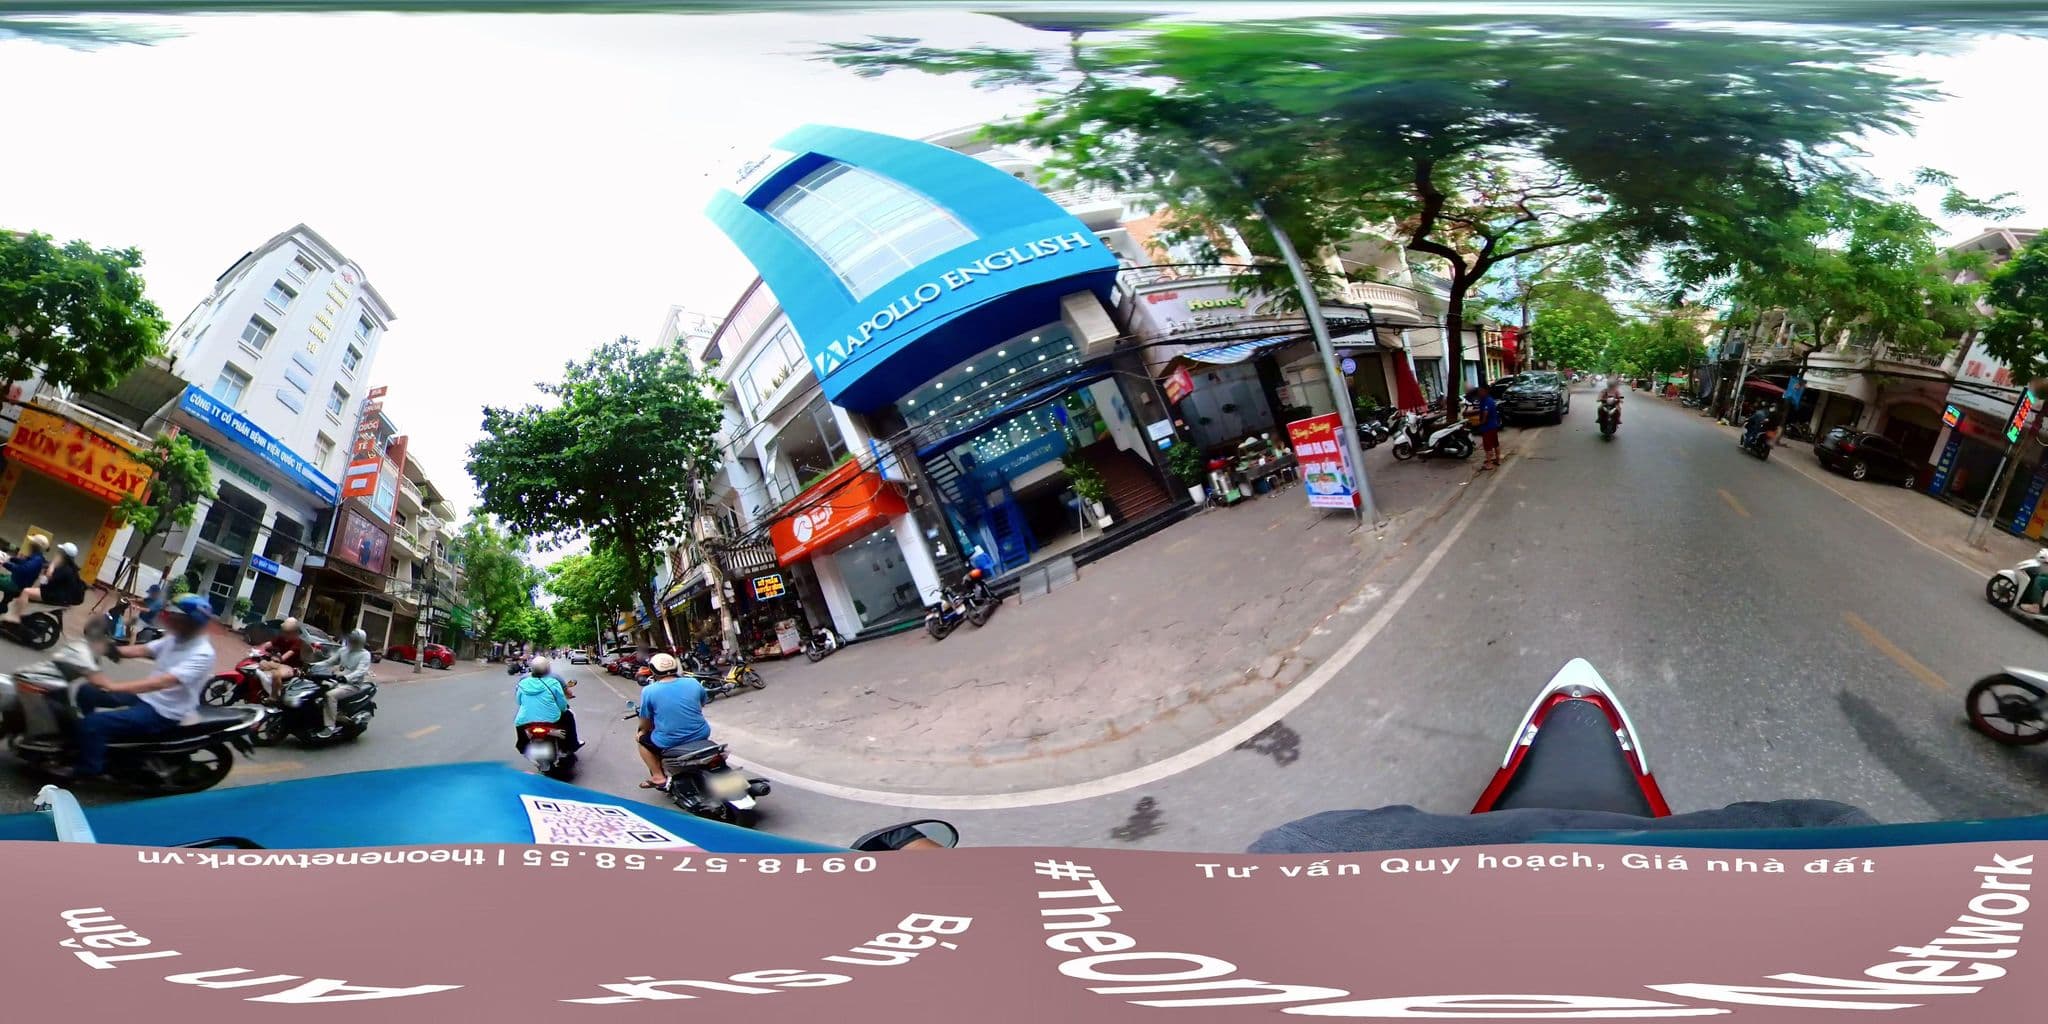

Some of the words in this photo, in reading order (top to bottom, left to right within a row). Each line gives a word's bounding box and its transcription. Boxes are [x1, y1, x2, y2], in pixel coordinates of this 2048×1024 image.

[847, 282, 942, 355] APOLLO
[940, 231, 1091, 290] ENGLISH
[1187, 297, 1248, 311] Honey
[13, 426, 60, 457] BÚN
[100, 465, 143, 493] CAY
[189, 392, 211, 412] CÔNG
[211, 404, 222, 418] TY
[250, 429, 267, 449] BỆNH
[280, 451, 296, 468] QUỐC
